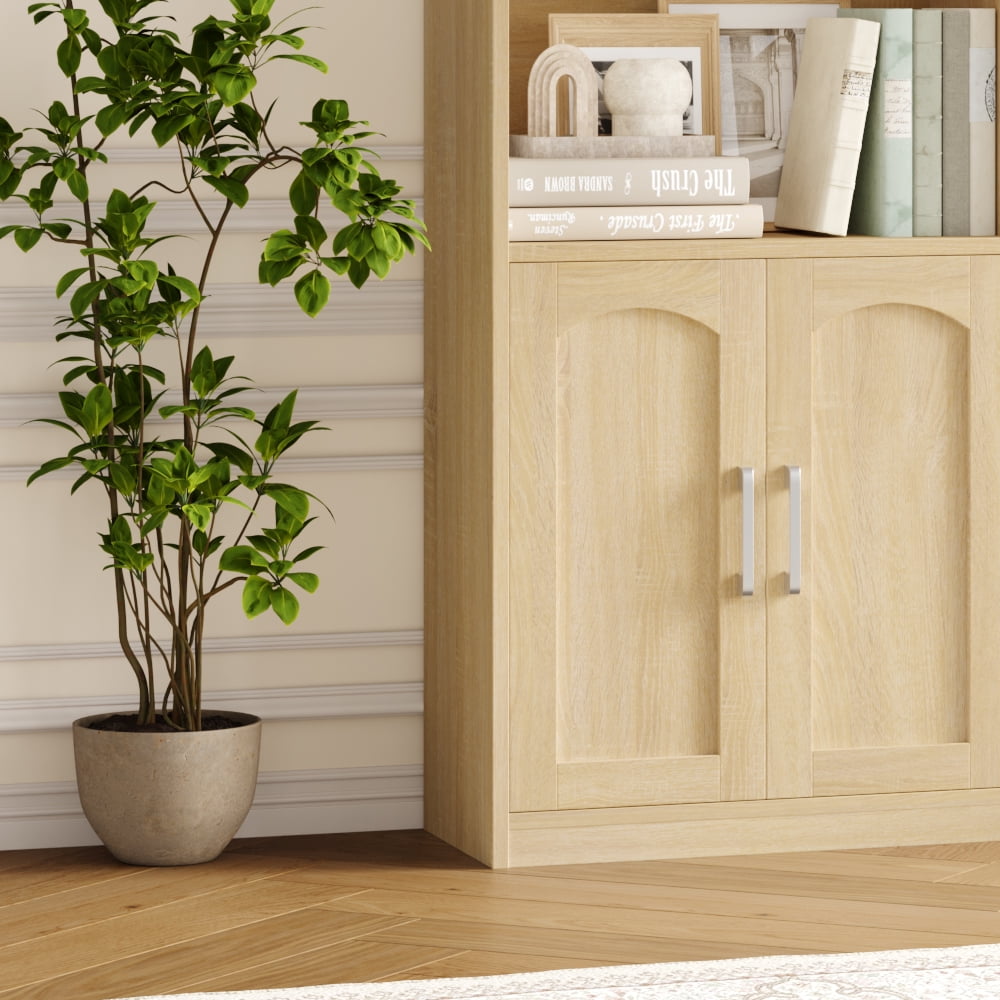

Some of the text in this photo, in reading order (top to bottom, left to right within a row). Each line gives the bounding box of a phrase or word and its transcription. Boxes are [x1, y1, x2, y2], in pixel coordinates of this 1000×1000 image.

[545, 176, 613, 192] SANDRA BROWN
[651, 169, 735, 197] The Crush
[535, 224, 568, 236] Steven
[608, 213, 737, 233] The First Crusade
